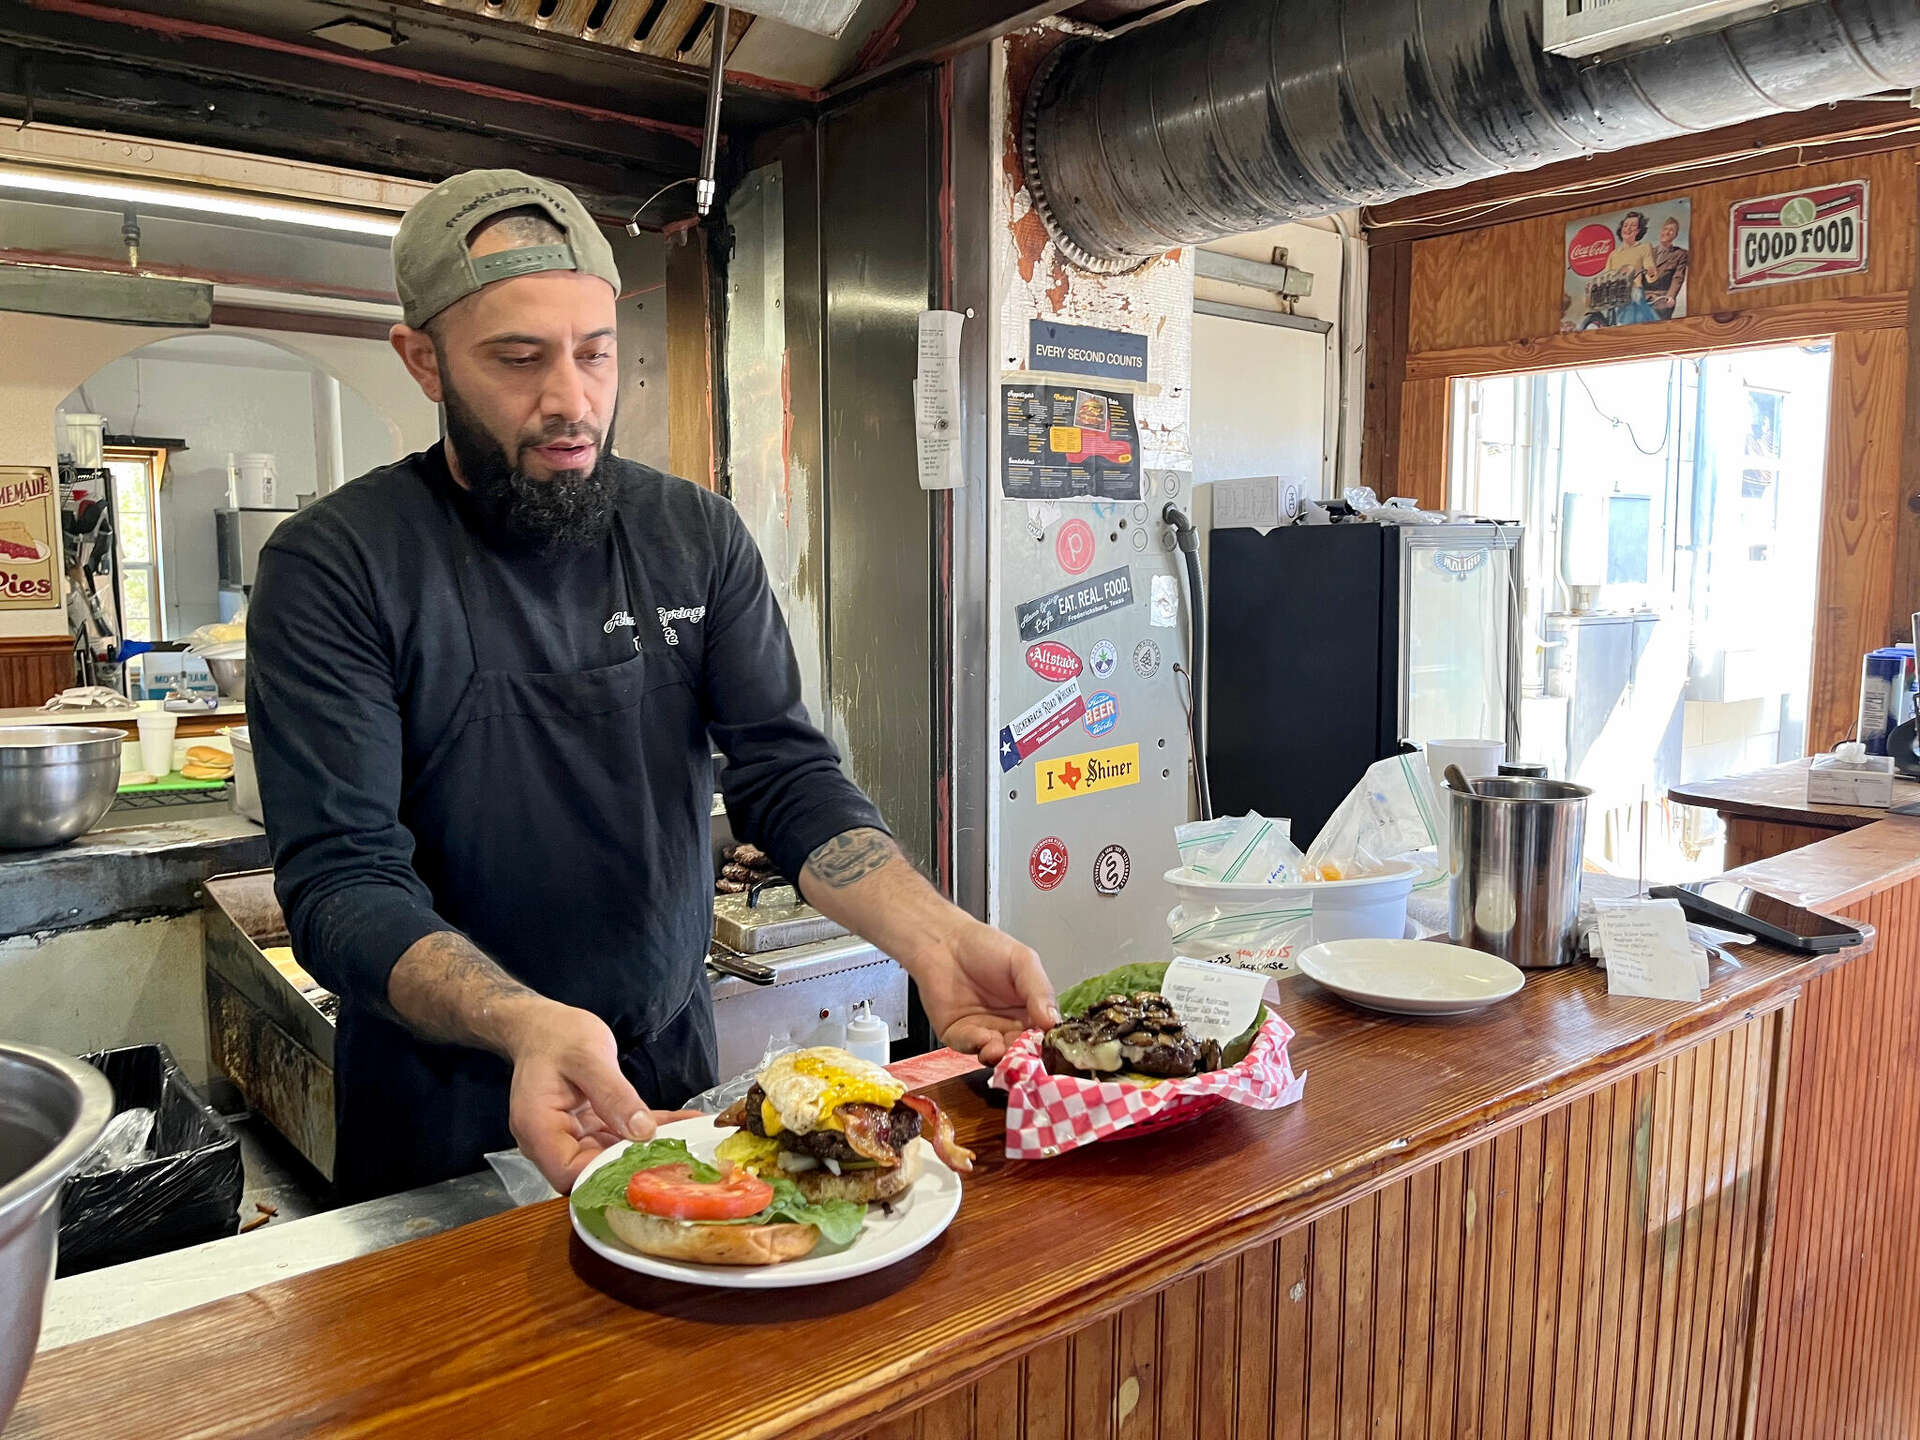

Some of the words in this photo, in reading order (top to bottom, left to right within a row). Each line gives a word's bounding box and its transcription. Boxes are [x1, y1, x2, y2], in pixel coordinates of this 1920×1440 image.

[1745, 232, 1796, 268] GOOD
[1801, 216, 1854, 253] FOOD
[1036, 344, 1066, 358] EVERY
[1067, 348, 1105, 363] SECOND
[1107, 353, 1143, 368] COUNTS
[1058, 593, 1078, 615] EAT.
[1079, 585, 1104, 609] REAL.
[1104, 576, 1130, 599] FOOD.
[1110, 598, 1125, 608] Texas
[1032, 647, 1075, 669] Altstadt
[1085, 701, 1115, 725] BEER
[1047, 771, 1054, 790] I
[1085, 758, 1132, 788] Shiner
